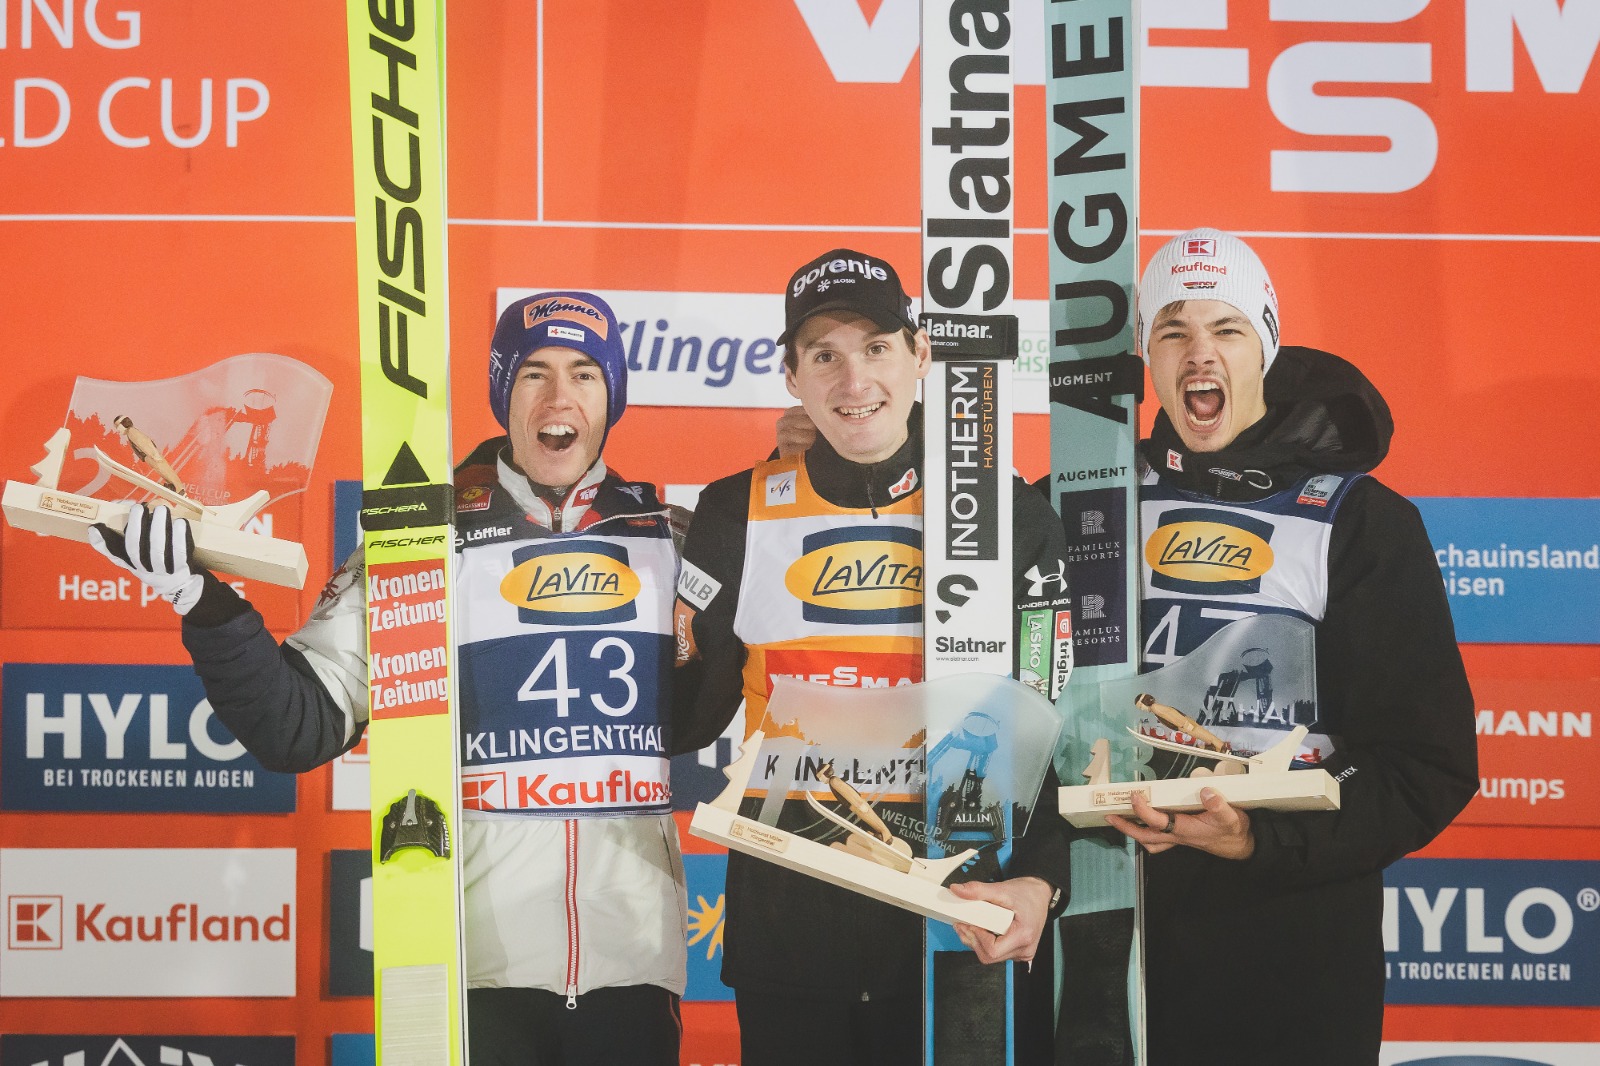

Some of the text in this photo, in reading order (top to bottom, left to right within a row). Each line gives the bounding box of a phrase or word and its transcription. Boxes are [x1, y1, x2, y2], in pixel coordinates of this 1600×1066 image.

[0, 78, 270, 148] D CUP
[926, 0, 1012, 312] Slatna
[793, 259, 888, 298] gorenje
[1171, 262, 1227, 275] Kaufland
[528, 300, 604, 322] Manner
[920, 318, 990, 339] latnar
[618, 319, 786, 388] linge
[981, 366, 994, 469] HAUSTÜREN
[951, 366, 979, 556] INOTHERM
[1057, 466, 1128, 483] AUGMENT
[368, 535, 446, 549] FISCHER
[467, 527, 512, 542] Löffler
[1067, 541, 1120, 553] FAMILUX
[1068, 550, 1120, 563] RESORTS
[59, 574, 131, 601] Heat
[368, 568, 445, 603] Kronen
[680, 570, 714, 601] NLB
[1443, 571, 1505, 597] isen
[369, 599, 446, 633] Zeitung
[677, 614, 690, 661] ARGETA
[935, 636, 1006, 653] Slatnar
[1025, 614, 1045, 669] LAŠKO
[370, 646, 447, 681] Kronen
[517, 637, 638, 718] 43
[1056, 640, 1069, 693] triglav
[371, 677, 449, 711] Zeitung
[466, 725, 666, 761] KLINGENTHAL
[44, 769, 255, 788] BEI TROCKENEN AUGEN
[518, 769, 671, 809] Kauflan
[880, 809, 943, 838] WELTCUP
[954, 813, 991, 823] ALL IN
[898, 827, 957, 855] KLINGENTHAL
[76, 903, 290, 943] Kaufland
[1398, 962, 1504, 981] TROCKENEN
[1511, 963, 1571, 981] AUGEN
